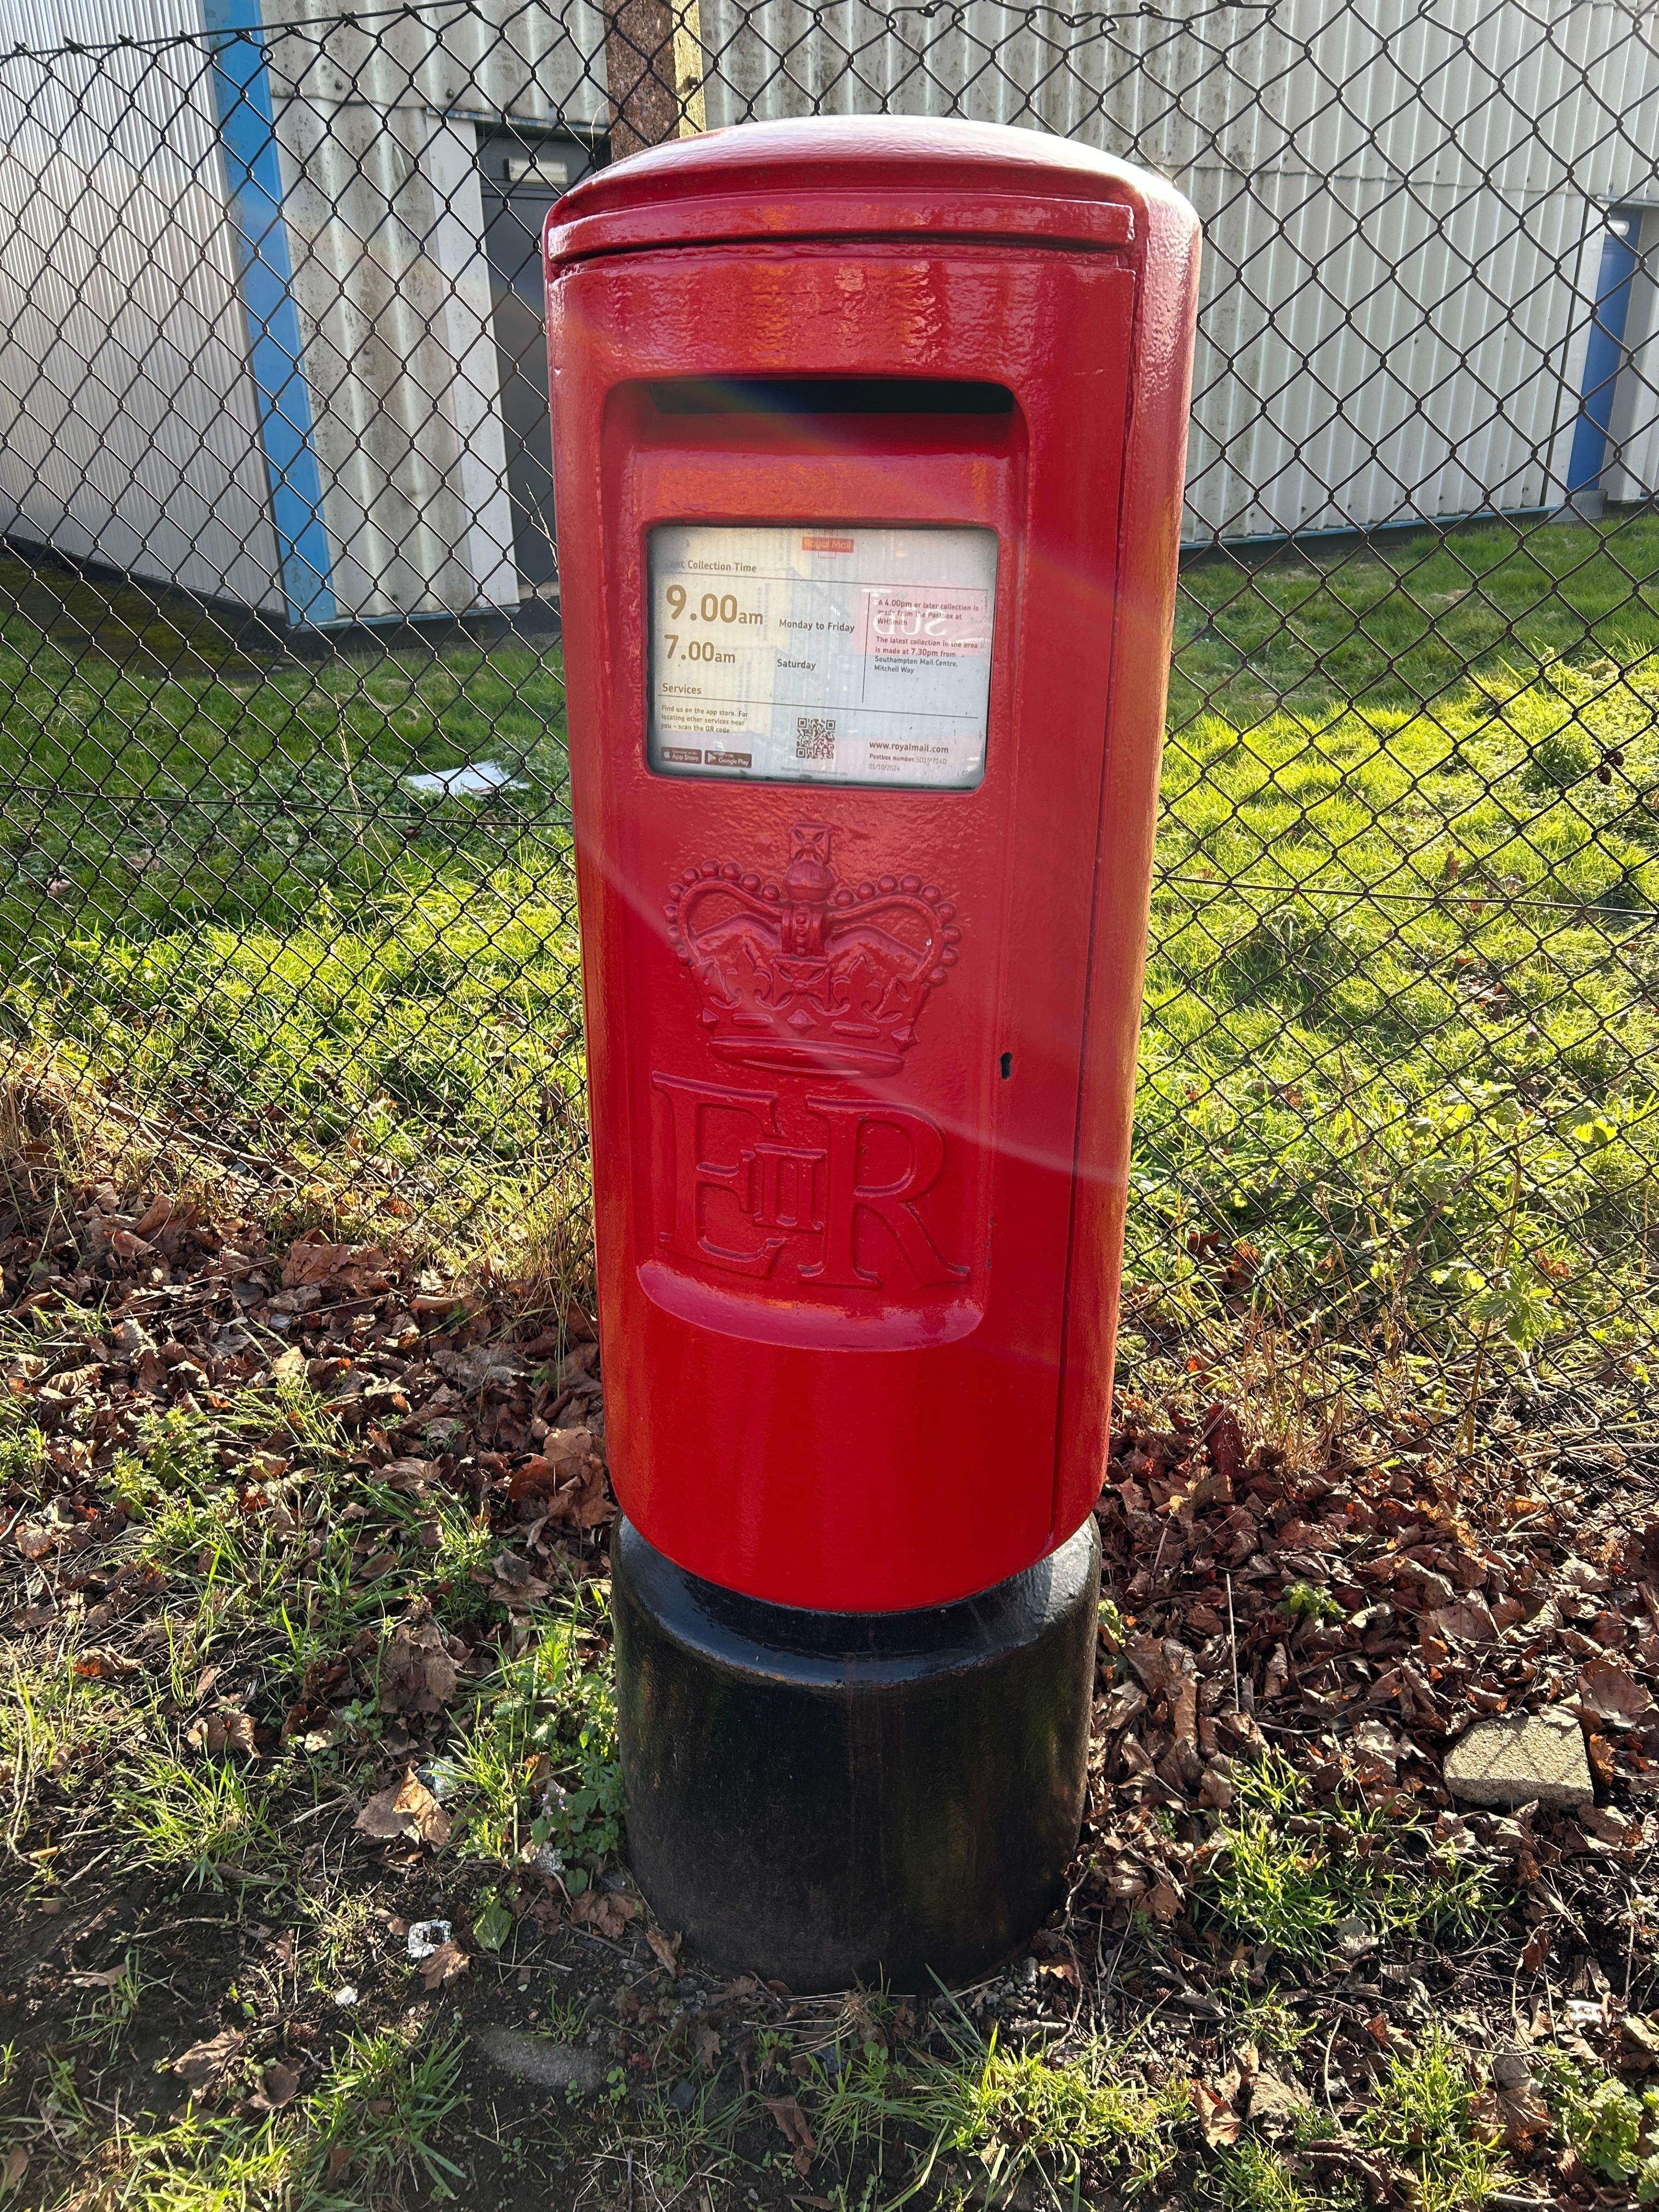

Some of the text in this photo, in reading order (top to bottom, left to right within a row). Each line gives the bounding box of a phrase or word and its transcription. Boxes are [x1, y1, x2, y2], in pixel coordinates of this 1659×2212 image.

[805, 539, 851, 550] Royal Mail
[687, 560, 731, 571] Collection
[734, 562, 757, 572] Time
[666, 584, 764, 625] 9.00am
[884, 599, 912, 608] 4.00pm
[779, 619, 855, 633] Monday to Friday
[890, 636, 908, 645] latest
[910, 637, 940, 646] collection
[664, 634, 735, 663] 7.00am
[911, 648, 938, 658] 7.30pm
[777, 659, 816, 671] Saturday
[874, 655, 917, 665] Southampton
[935, 659, 958, 668] Centre,
[874, 664, 915, 674] Mitchell Way
[662, 683, 702, 695] Services
[661, 714, 685, 722] locating
[869, 742, 949, 754] www.royalmail.com
[718, 757, 738, 765] Google
[868, 763, 900, 771] 01/10/2024
